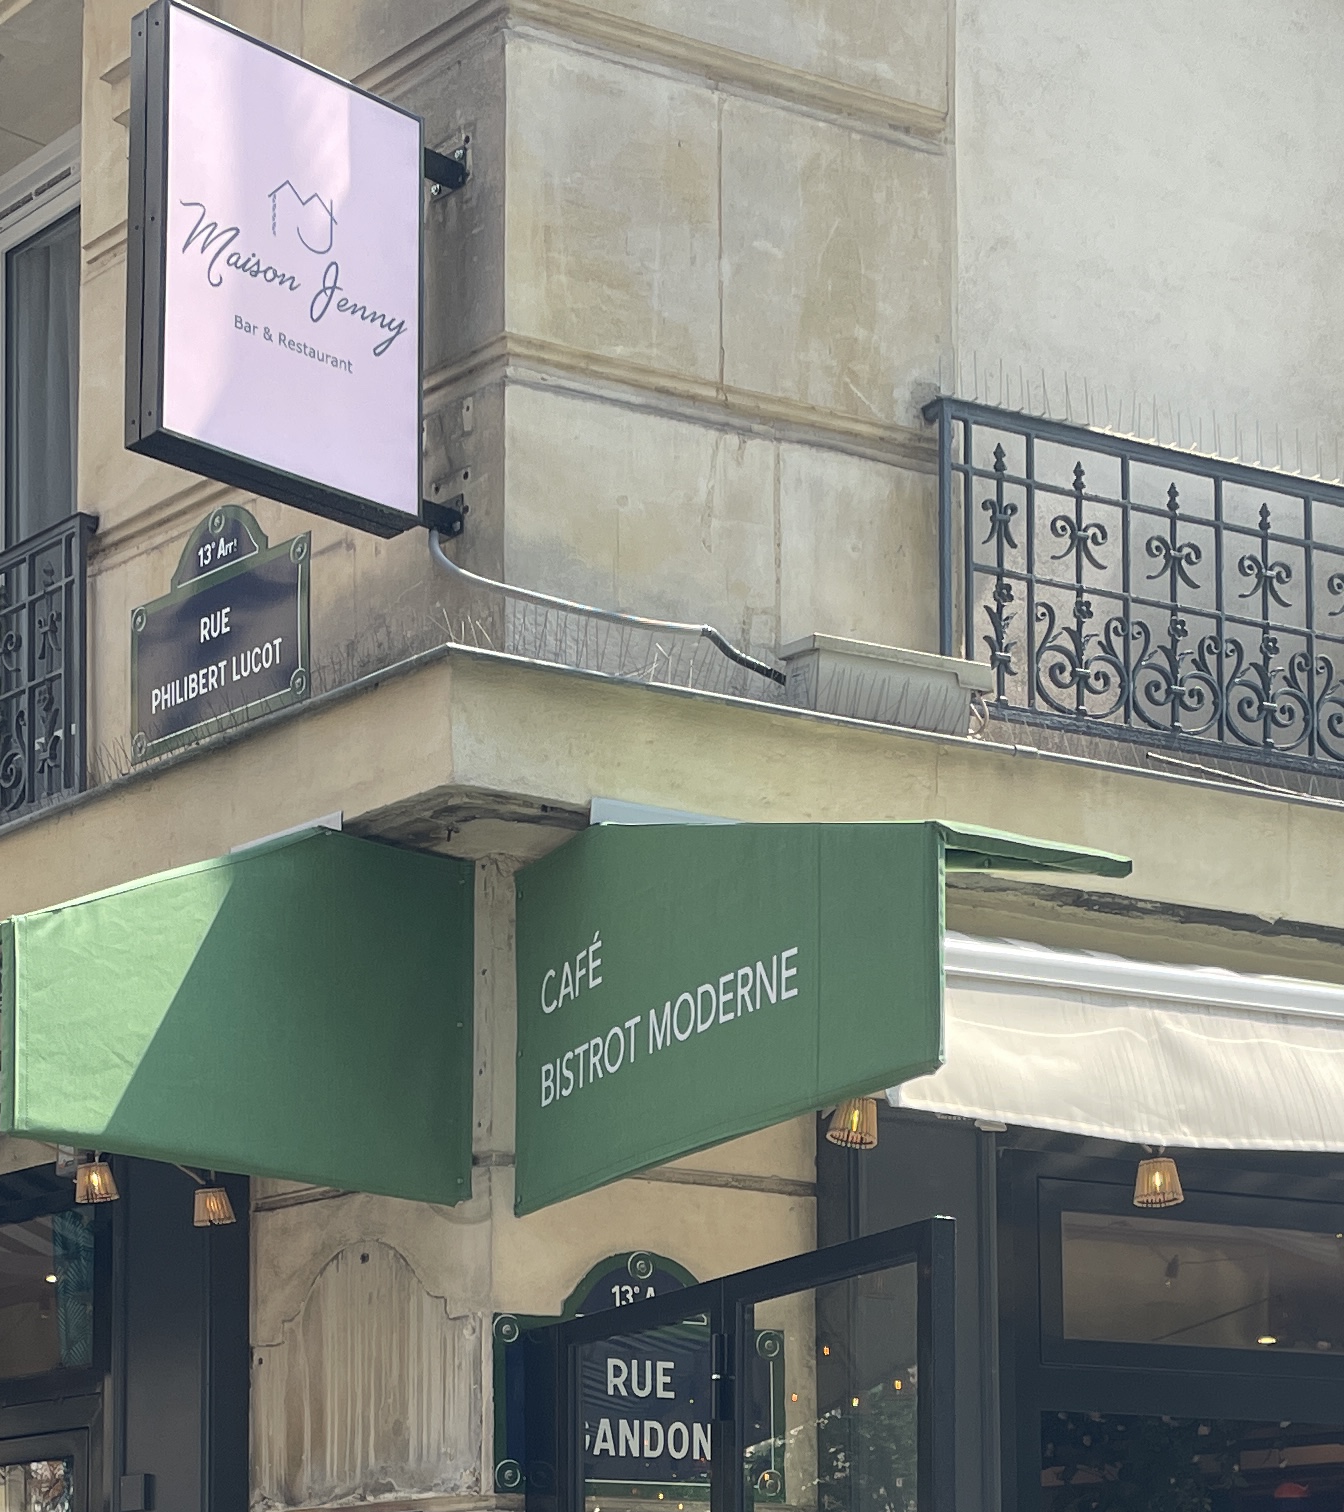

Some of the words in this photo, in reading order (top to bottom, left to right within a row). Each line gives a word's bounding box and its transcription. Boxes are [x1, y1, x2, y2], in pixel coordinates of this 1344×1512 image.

[179, 198, 301, 291] Maison
[310, 261, 408, 357] Jenny
[233, 314, 258, 336] Bar
[263, 326, 273, 343] &
[278, 331, 354, 374] Restaurant
[199, 606, 231, 643] RUE
[151, 659, 227, 715] PHILIBERT
[232, 637, 283, 683] LUCOT
[541, 930, 603, 1014] CAFÉ
[541, 1015, 642, 1108] BISTROT
[648, 946, 799, 1055] MODERNE
[606, 1357, 676, 1400] RUE
[584, 1418, 712, 1461] ANDON
